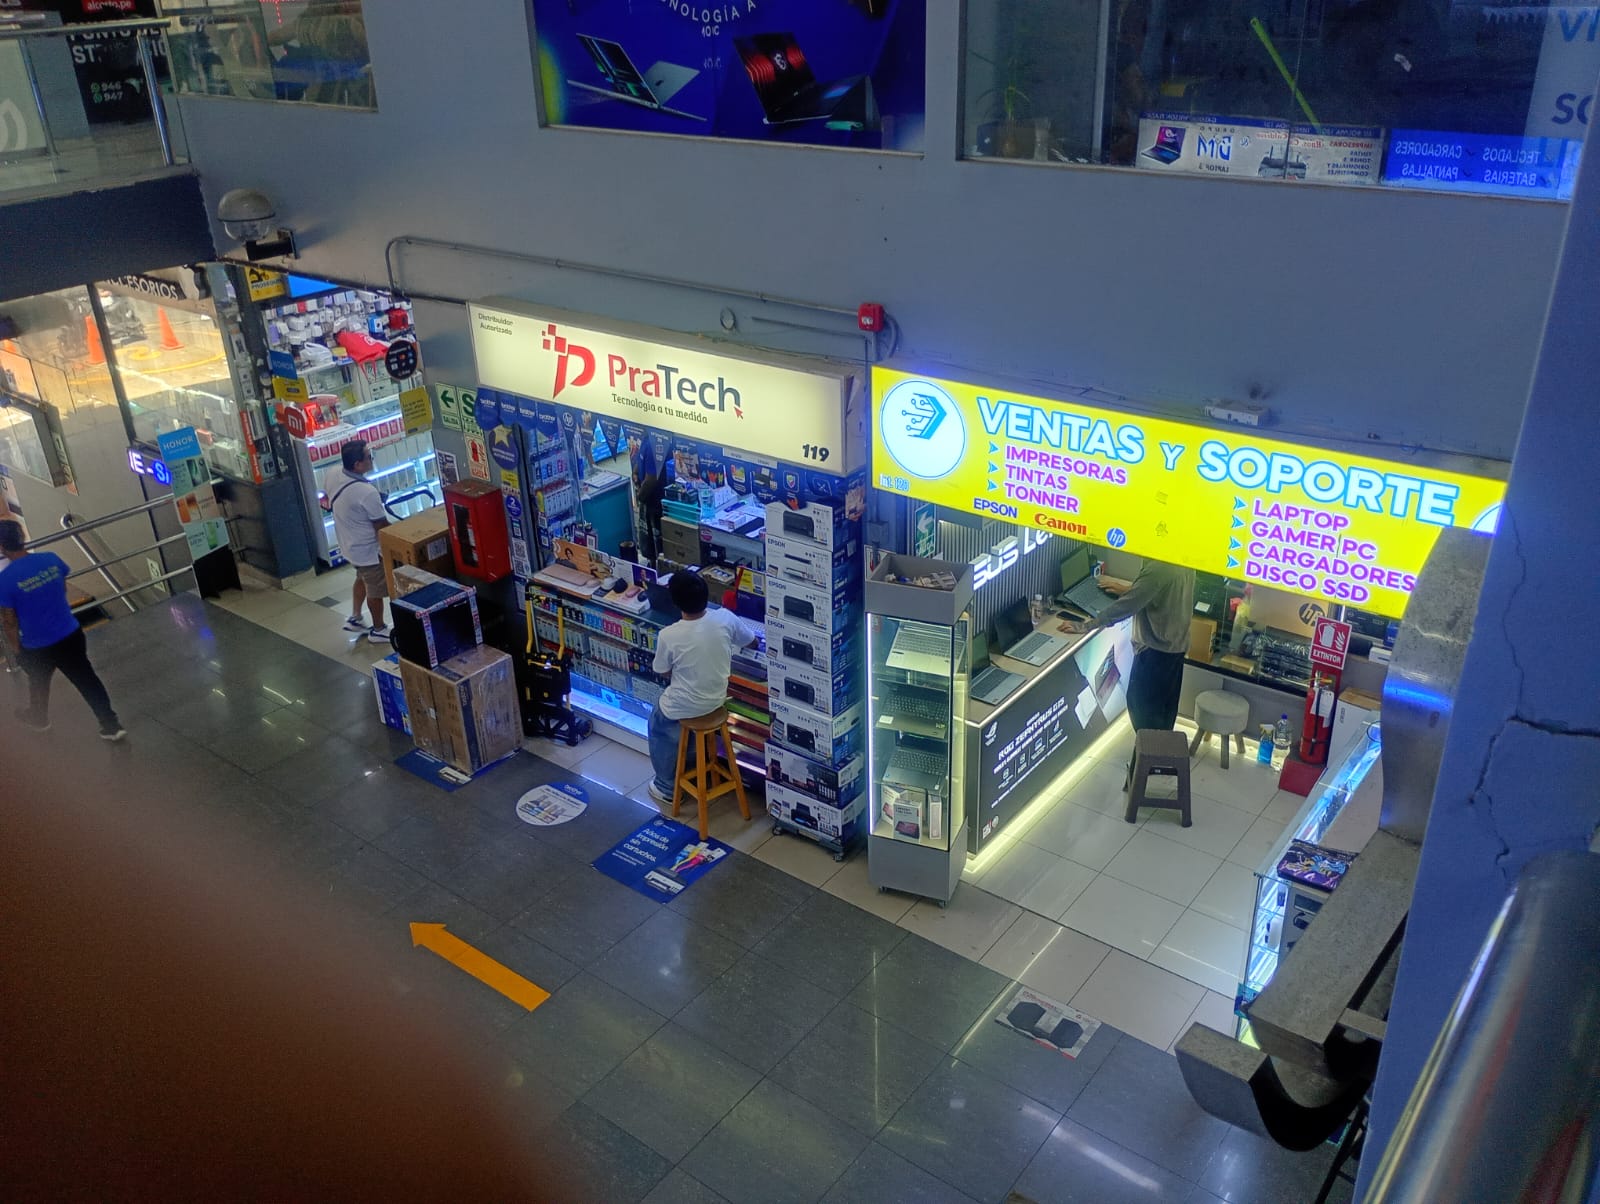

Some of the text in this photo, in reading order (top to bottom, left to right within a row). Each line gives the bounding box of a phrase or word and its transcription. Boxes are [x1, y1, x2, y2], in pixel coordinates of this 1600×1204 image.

[480, 322, 513, 336] Autorizado
[608, 354, 741, 412] PraTech
[675, 408, 708, 424] medida
[163, 436, 193, 450] HONOR
[802, 444, 830, 462] 119
[976, 396, 1460, 528] VENTAS Y SOPORTE
[1005, 444, 1128, 486] IMPRESORAS
[1005, 463, 1069, 491] TINTAS
[1004, 482, 1080, 514] TONNER
[973, 498, 1018, 519] EPSON
[1253, 499, 1350, 532] LAPTOP
[1034, 513, 1088, 536] Canon
[768, 538, 785, 548] EPSON
[1108, 529, 1125, 547] hp
[1251, 521, 1378, 562] GAMER PC
[1248, 541, 1417, 593] CARGADORES
[769, 580, 786, 590] EPSON
[1245, 560, 1370, 604] DISCO SSD
[768, 620, 784, 629] EPSON
[770, 661, 786, 670] EPSON
[1312, 649, 1342, 664] EXTINTOR
[771, 701, 788, 712] EPSON
[768, 747, 783, 758] EPSON
[768, 783, 783, 794] EPSON
